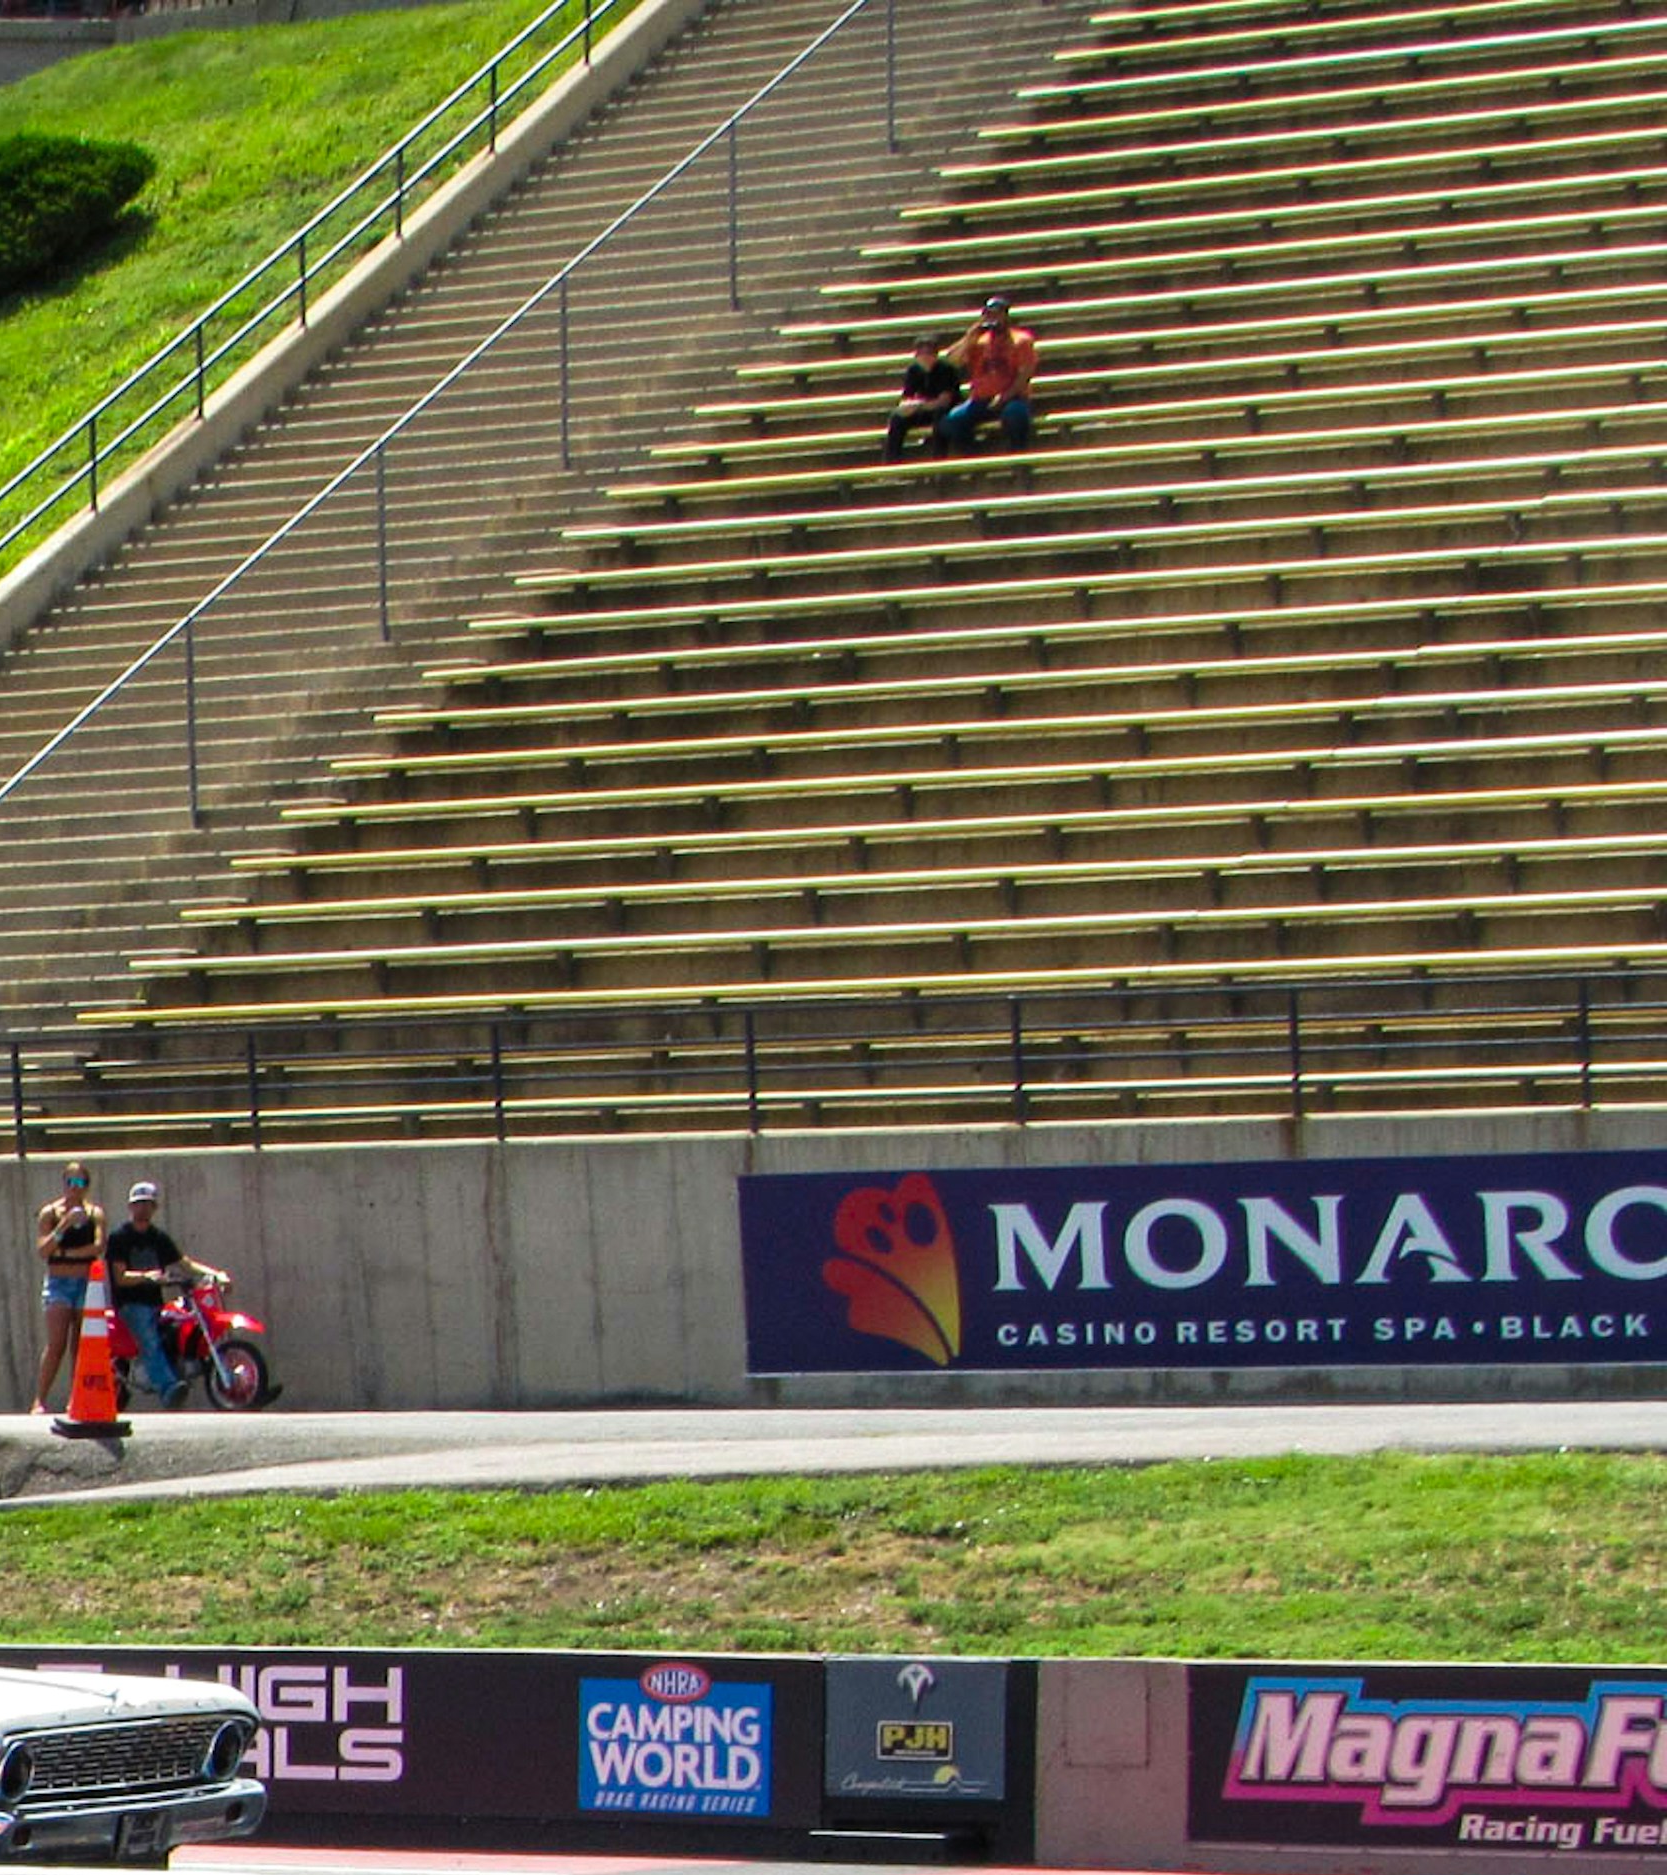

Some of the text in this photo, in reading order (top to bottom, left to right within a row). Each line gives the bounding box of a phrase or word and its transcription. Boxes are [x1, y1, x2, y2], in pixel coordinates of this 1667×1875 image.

[998, 1313, 1649, 1345] CASINO RESORT SPA BLACK
[648, 1669, 702, 1695] NHRA
[587, 1703, 761, 1743] CAMPING
[882, 1726, 948, 1749] PJH
[1239, 1692, 1667, 1806] MagnaF
[588, 1742, 761, 1791] WORLD
[639, 1792, 697, 1811] RACING
[701, 1796, 758, 1813] SERIES
[1459, 1815, 1583, 1850] Racing
